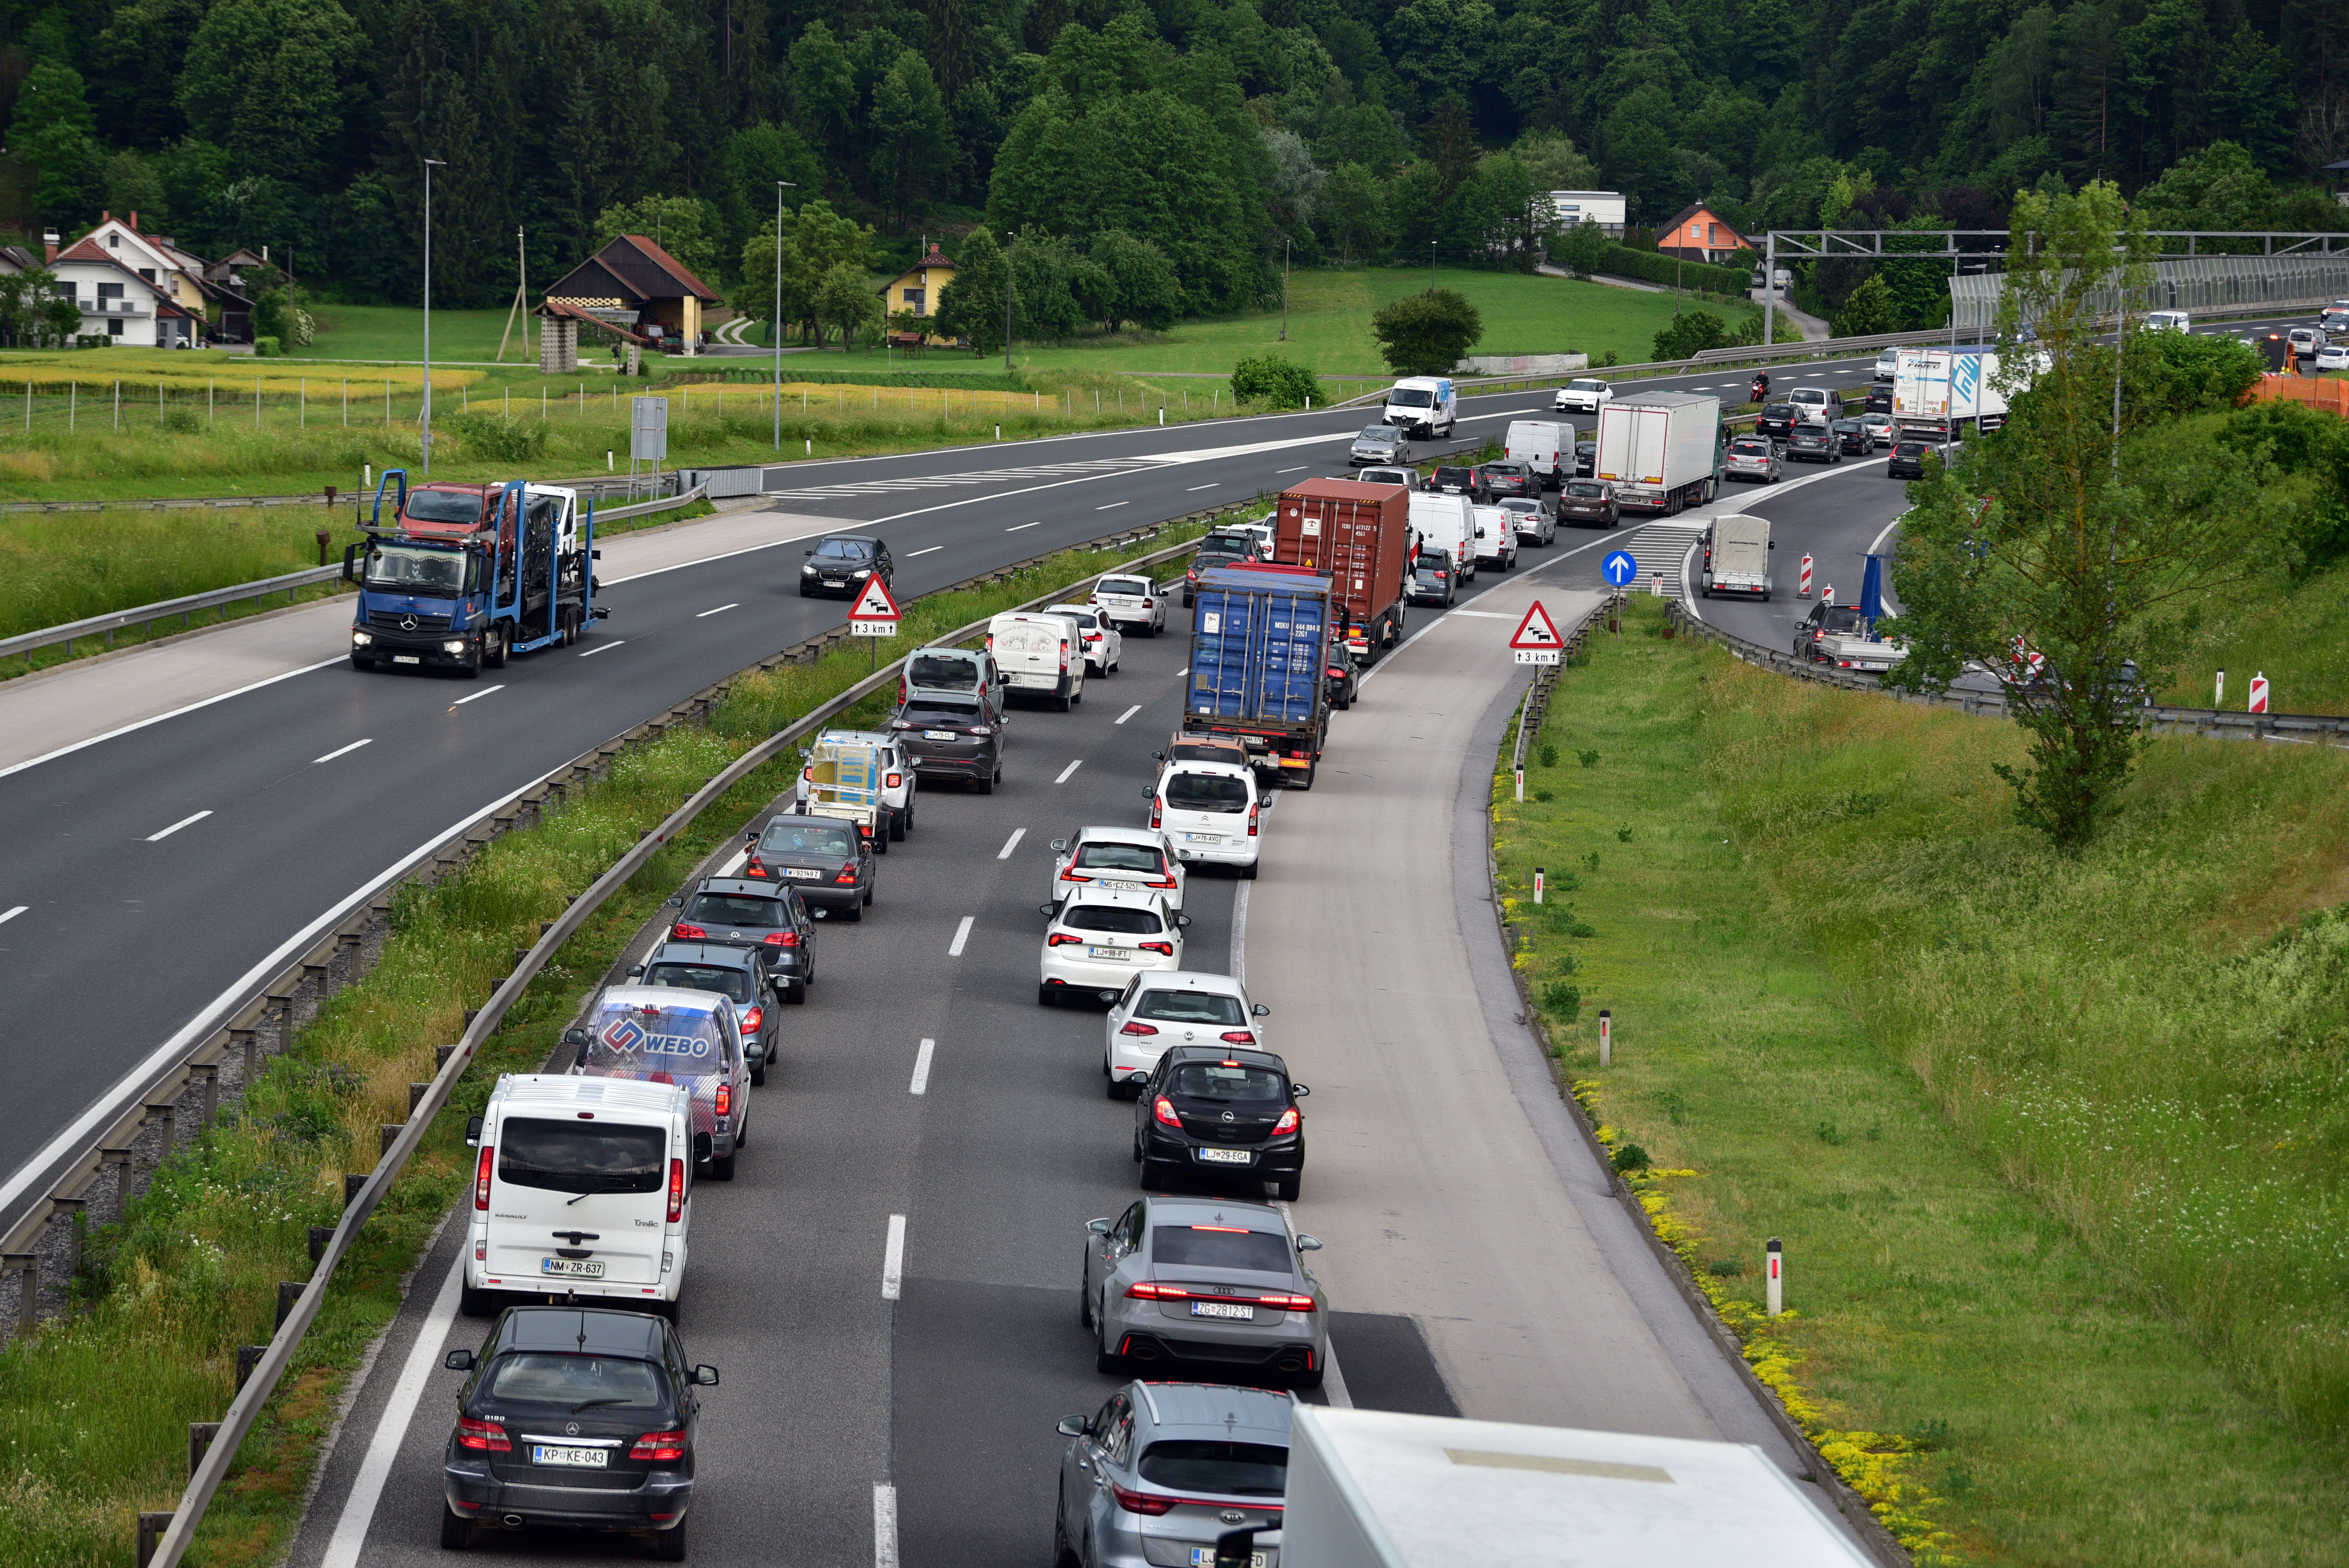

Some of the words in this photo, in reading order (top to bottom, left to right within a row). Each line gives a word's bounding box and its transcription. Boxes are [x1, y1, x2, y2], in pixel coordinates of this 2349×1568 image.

[863, 624, 868, 633] 3
[873, 624, 885, 633] km
[1525, 652, 1530, 661] 3
[1535, 653, 1548, 662] km
[645, 1035, 707, 1055] WEBO
[1221, 1151, 1248, 1161] 29-EGA
[634, 1219, 659, 1228] Trafic
[551, 1261, 564, 1270] NM
[571, 1263, 601, 1273] ZR-637
[1199, 1304, 1210, 1313] ZG
[1217, 1306, 1252, 1317] 2812-ST
[544, 1449, 558, 1460] KP
[567, 1450, 604, 1464] KE-043
[1202, 1551, 1216, 1563] LJ
